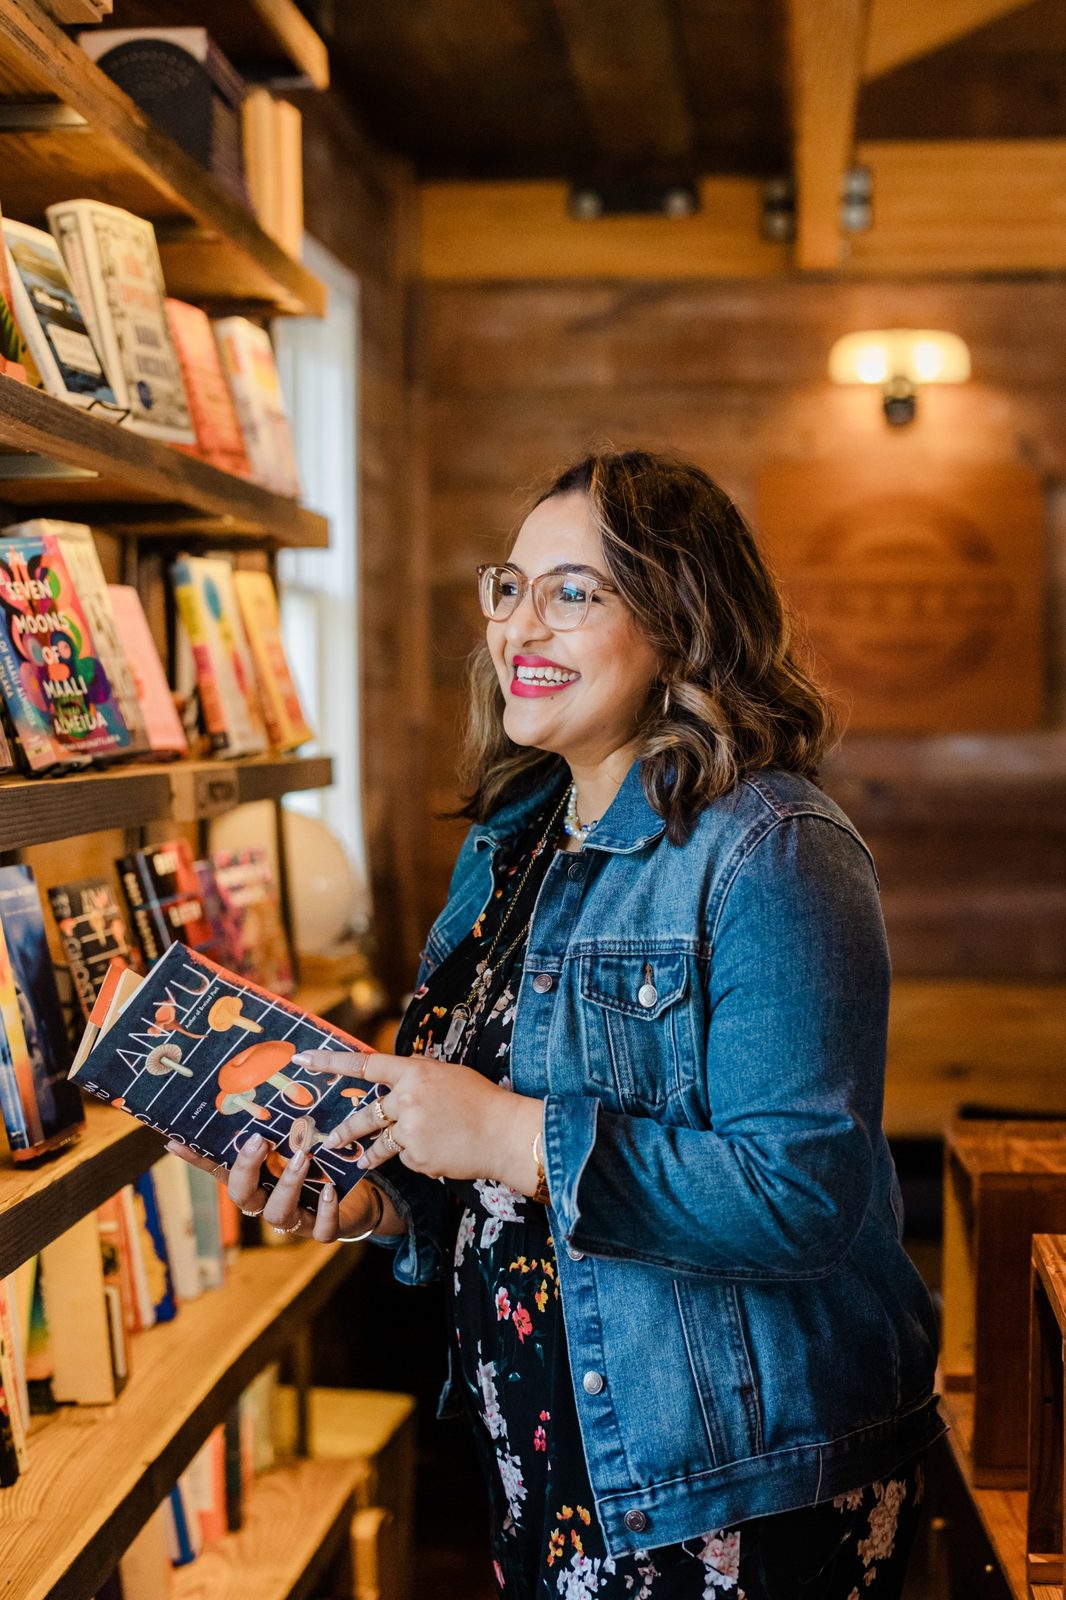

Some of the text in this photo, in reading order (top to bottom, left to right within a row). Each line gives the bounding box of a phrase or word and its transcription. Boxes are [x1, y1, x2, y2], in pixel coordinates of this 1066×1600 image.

[5, 579, 54, 601] SEVEN
[12, 611, 71, 634] MOONS
[42, 645, 61, 665] OF
[42, 675, 88, 699] MAALI
[53, 711, 109, 735] ALMEIDA
[153, 963, 210, 1013] YU
[194, 1101, 208, 1117] NOVEL
